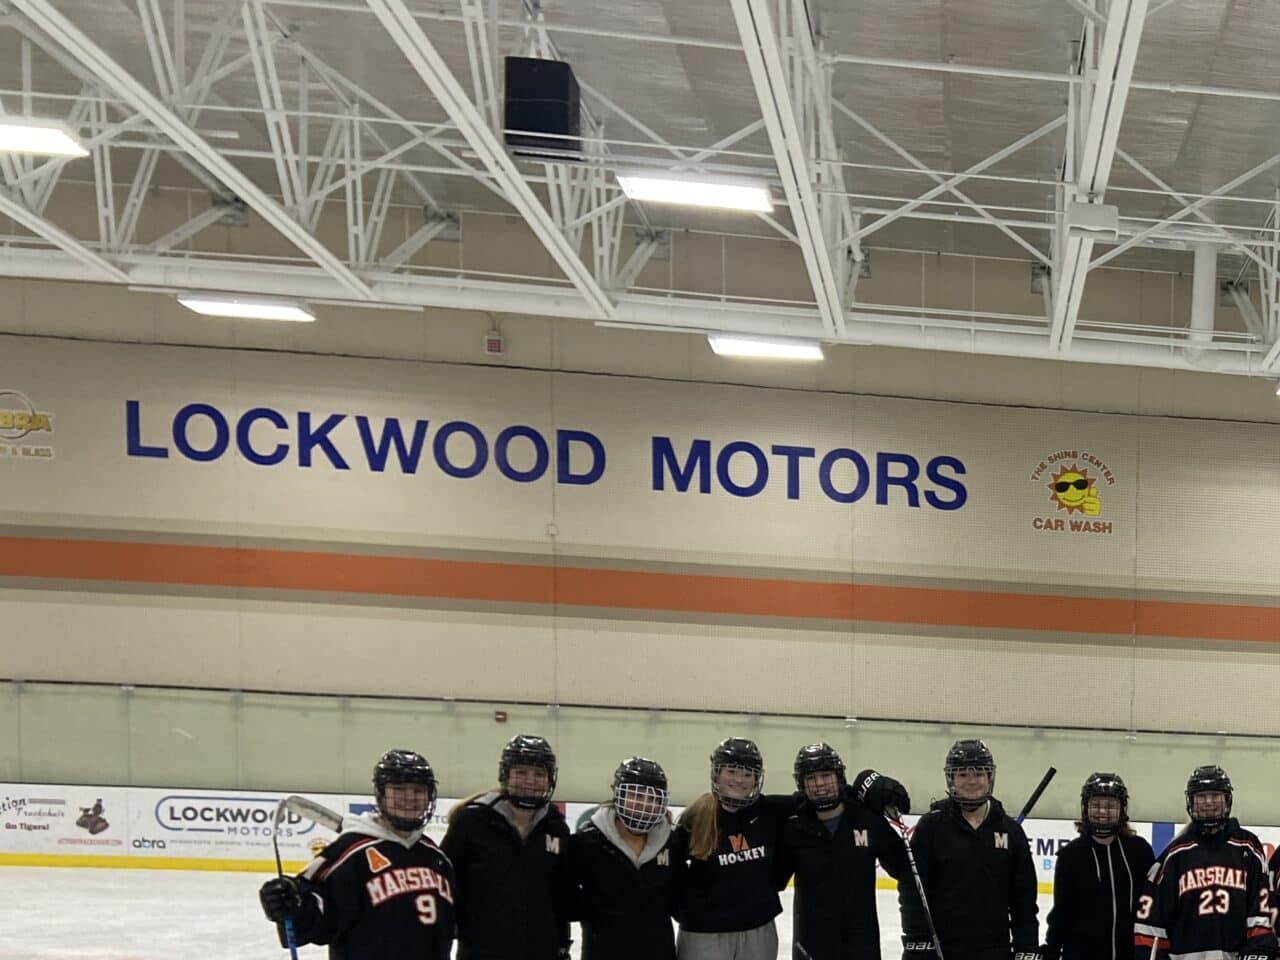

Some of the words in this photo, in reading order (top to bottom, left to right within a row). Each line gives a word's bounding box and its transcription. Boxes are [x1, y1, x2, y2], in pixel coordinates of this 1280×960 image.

[126, 399, 606, 486] LOCKWOOD
[651, 436, 968, 511] MOTORS
[1031, 462, 1048, 480] THE
[1047, 451, 1079, 464] SHINE
[1081, 452, 1115, 486] CENTER
[1033, 517, 1065, 531] CAR
[1069, 520, 1113, 534] WASH
[0, 796, 27, 815] tion
[5, 822, 17, 830] Go
[20, 822, 50, 831] Tigers!
[132, 837, 166, 850] abra
[545, 833, 561, 856] M
[853, 829, 870, 849] M
[994, 831, 1009, 850] M
[656, 849, 671, 868] M
[718, 845, 767, 867] HOCKEY
[415, 893, 437, 925] 9
[1198, 889, 1231, 916] 23
